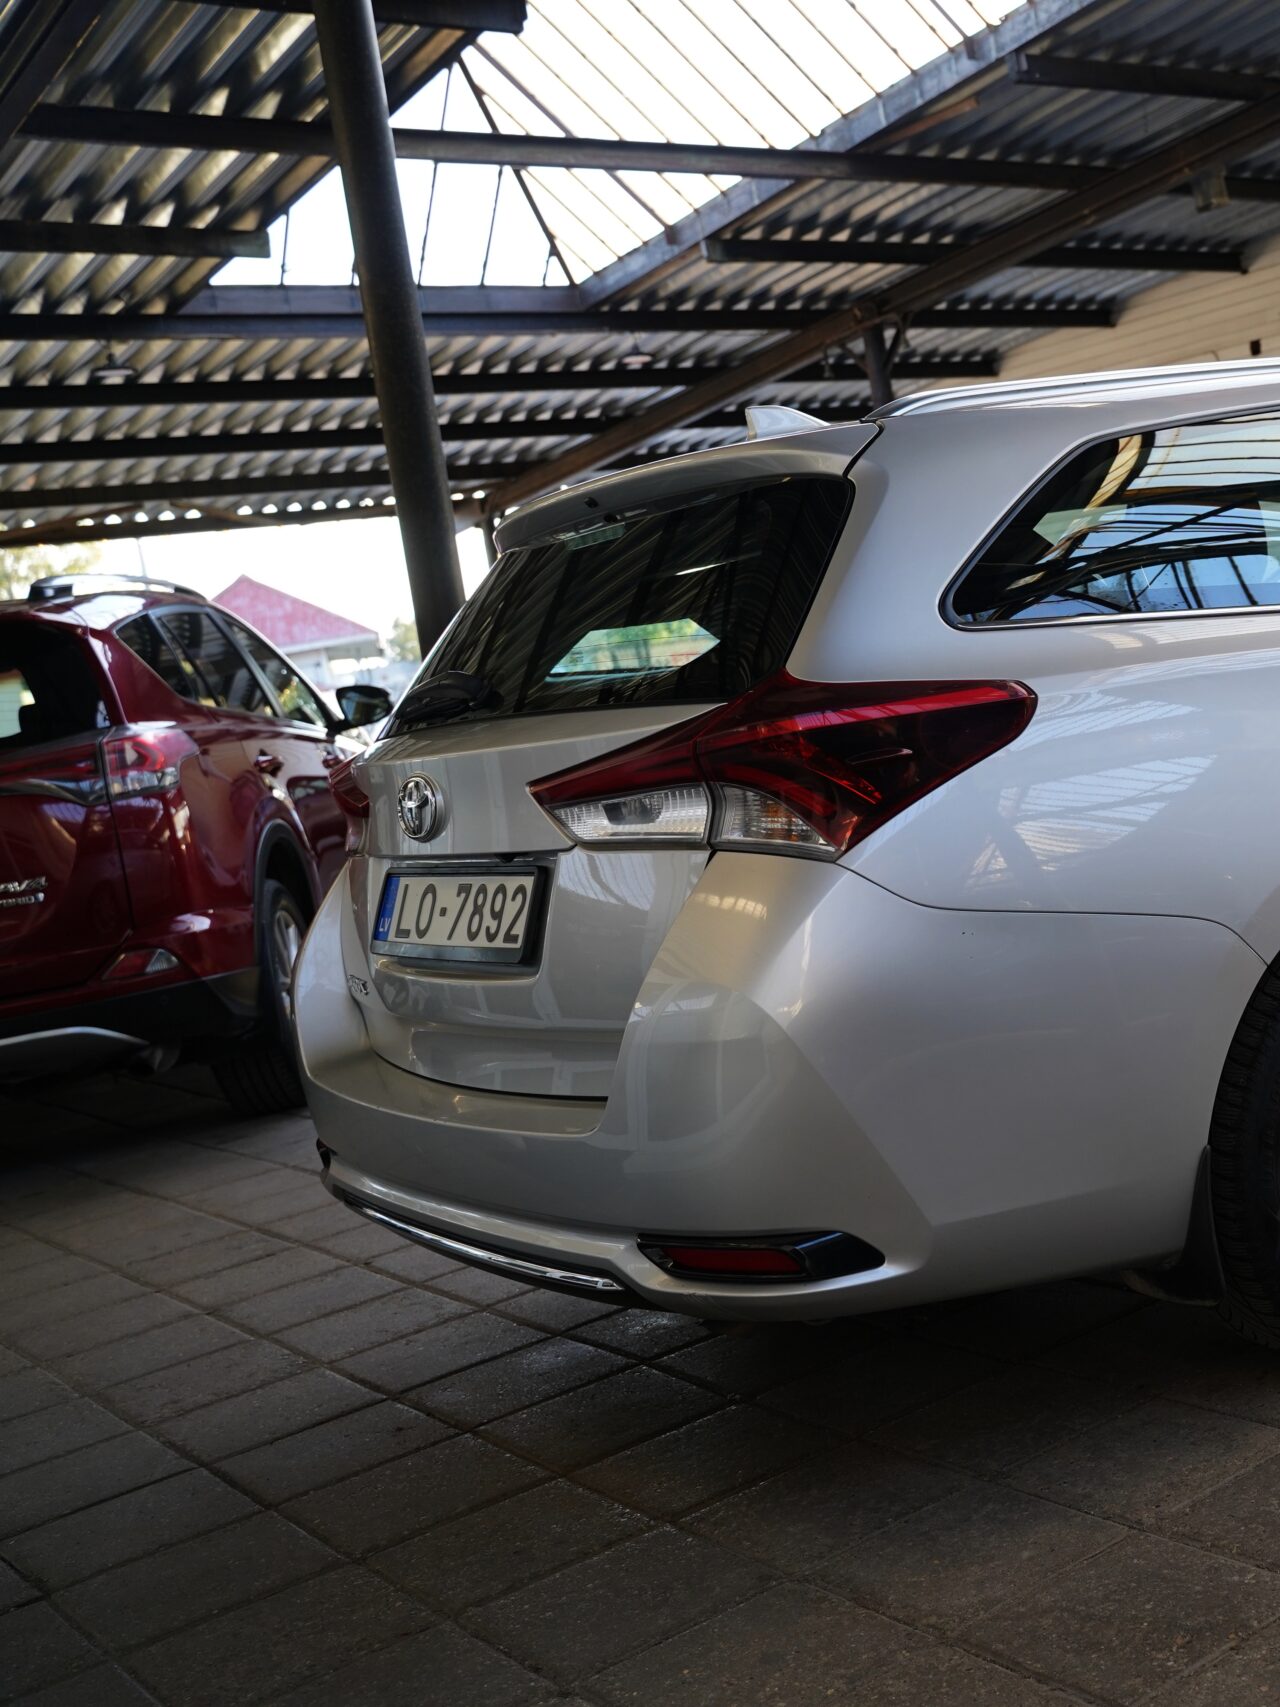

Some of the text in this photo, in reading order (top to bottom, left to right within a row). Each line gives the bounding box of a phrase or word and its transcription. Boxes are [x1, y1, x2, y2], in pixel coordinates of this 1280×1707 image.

[0, 877, 47, 892] AV4
[394, 883, 528, 945] LO-7892
[379, 918, 392, 932] LV
